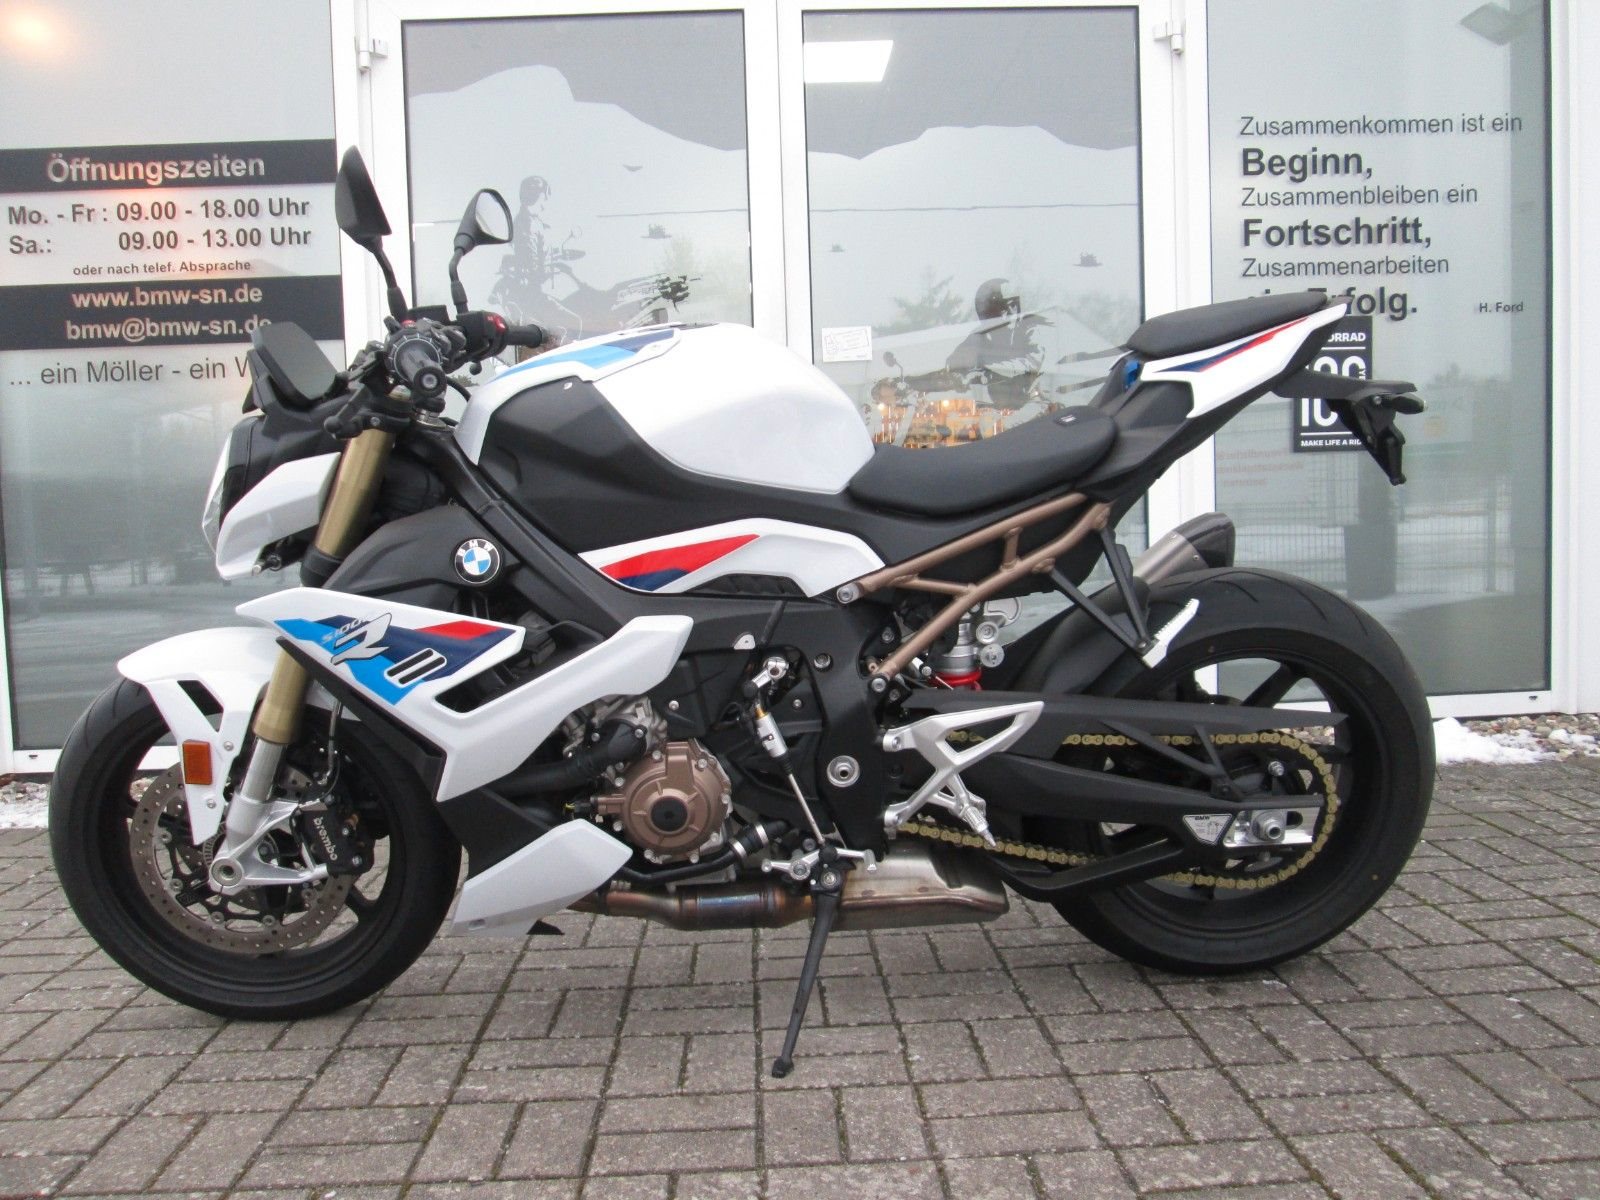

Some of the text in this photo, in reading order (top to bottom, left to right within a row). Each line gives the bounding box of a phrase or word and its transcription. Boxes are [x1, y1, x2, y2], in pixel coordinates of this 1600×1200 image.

[1240, 112, 1522, 136] Zusammenkommen ist ein
[48, 153, 265, 185] Öffnungszeiten
[1241, 146, 1373, 182] Beginn,
[1241, 184, 1478, 207] Zusammenbleiben ein
[8, 205, 48, 225] Mo.
[116, 201, 177, 222] 09.00
[200, 198, 260, 219] 18.00
[268, 197, 310, 217] Uhr
[9, 234, 51, 254] Sa.:
[118, 230, 179, 251] 09.00
[202, 228, 262, 248] 13.00
[270, 226, 312, 246] Uhr
[1243, 215, 1432, 249] Fortschritt,
[73, 260, 251, 275] oder nach telef. Absprache
[1242, 255, 1449, 278] Zusammenarbeiten
[72, 283, 263, 308] www.bmw-sn.de
[1479, 301, 1524, 313] H. Ford
[40, 362, 77, 385] ein
[87, 360, 164, 383] Möller
[189, 357, 226, 380] ein
[457, 539, 495, 557] BMW
[313, 816, 338, 861] brembo
